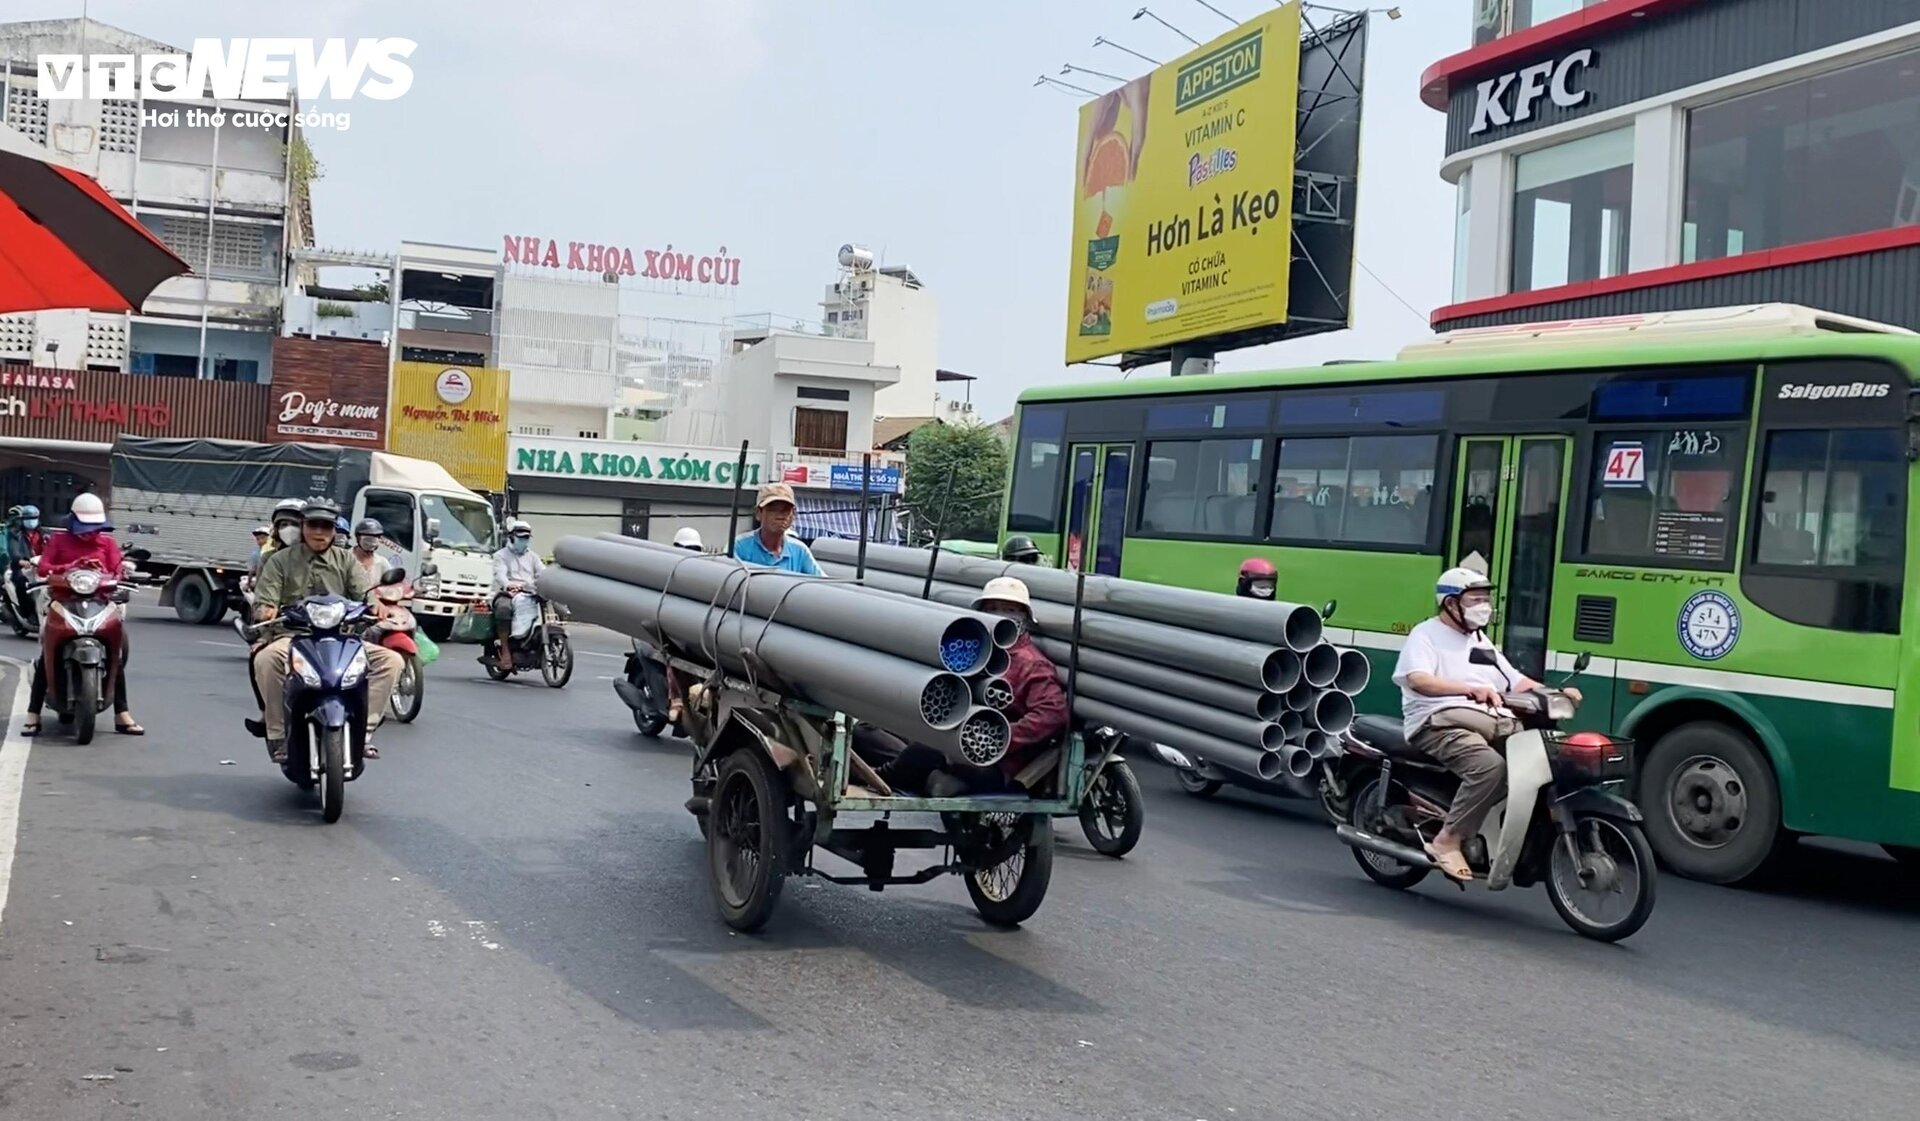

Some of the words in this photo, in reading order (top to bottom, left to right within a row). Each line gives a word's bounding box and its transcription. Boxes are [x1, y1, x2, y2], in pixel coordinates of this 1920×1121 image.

[1181, 43, 1257, 100] APPETON
[1469, 49, 1592, 134] KFC
[1185, 113, 1233, 148] VITAMIN
[1236, 108, 1245, 127] C
[1188, 147, 1237, 188] Pastilles
[1147, 213, 1190, 257] Hơn
[1197, 192, 1224, 240] Là
[1231, 189, 1280, 236] Kẹo
[503, 234, 560, 268] NHA
[566, 241, 636, 276] KHOA
[641, 244, 694, 282] XÓM
[697, 245, 741, 286] CỦI
[1188, 257, 1200, 275] CÓ
[1201, 250, 1226, 271] CHỨA
[1181, 273, 1219, 296] VITAMIN
[2, 373, 75, 390] FAHASA
[1778, 382, 1890, 400] SaigonBus
[278, 391, 339, 424] Dog's
[340, 403, 380, 419] mom
[517, 447, 576, 474] NHA
[580, 451, 653, 479] KHOA
[657, 452, 711, 483] XÓM
[1607, 450, 1642, 479] 47
[378, 535, 403, 554] SUZU
[458, 573, 478, 581] ISUZU
[1576, 569, 1636, 581] SAMCO
[1641, 572, 1685, 584] CITY
[1696, 628, 1719, 641] 47N
